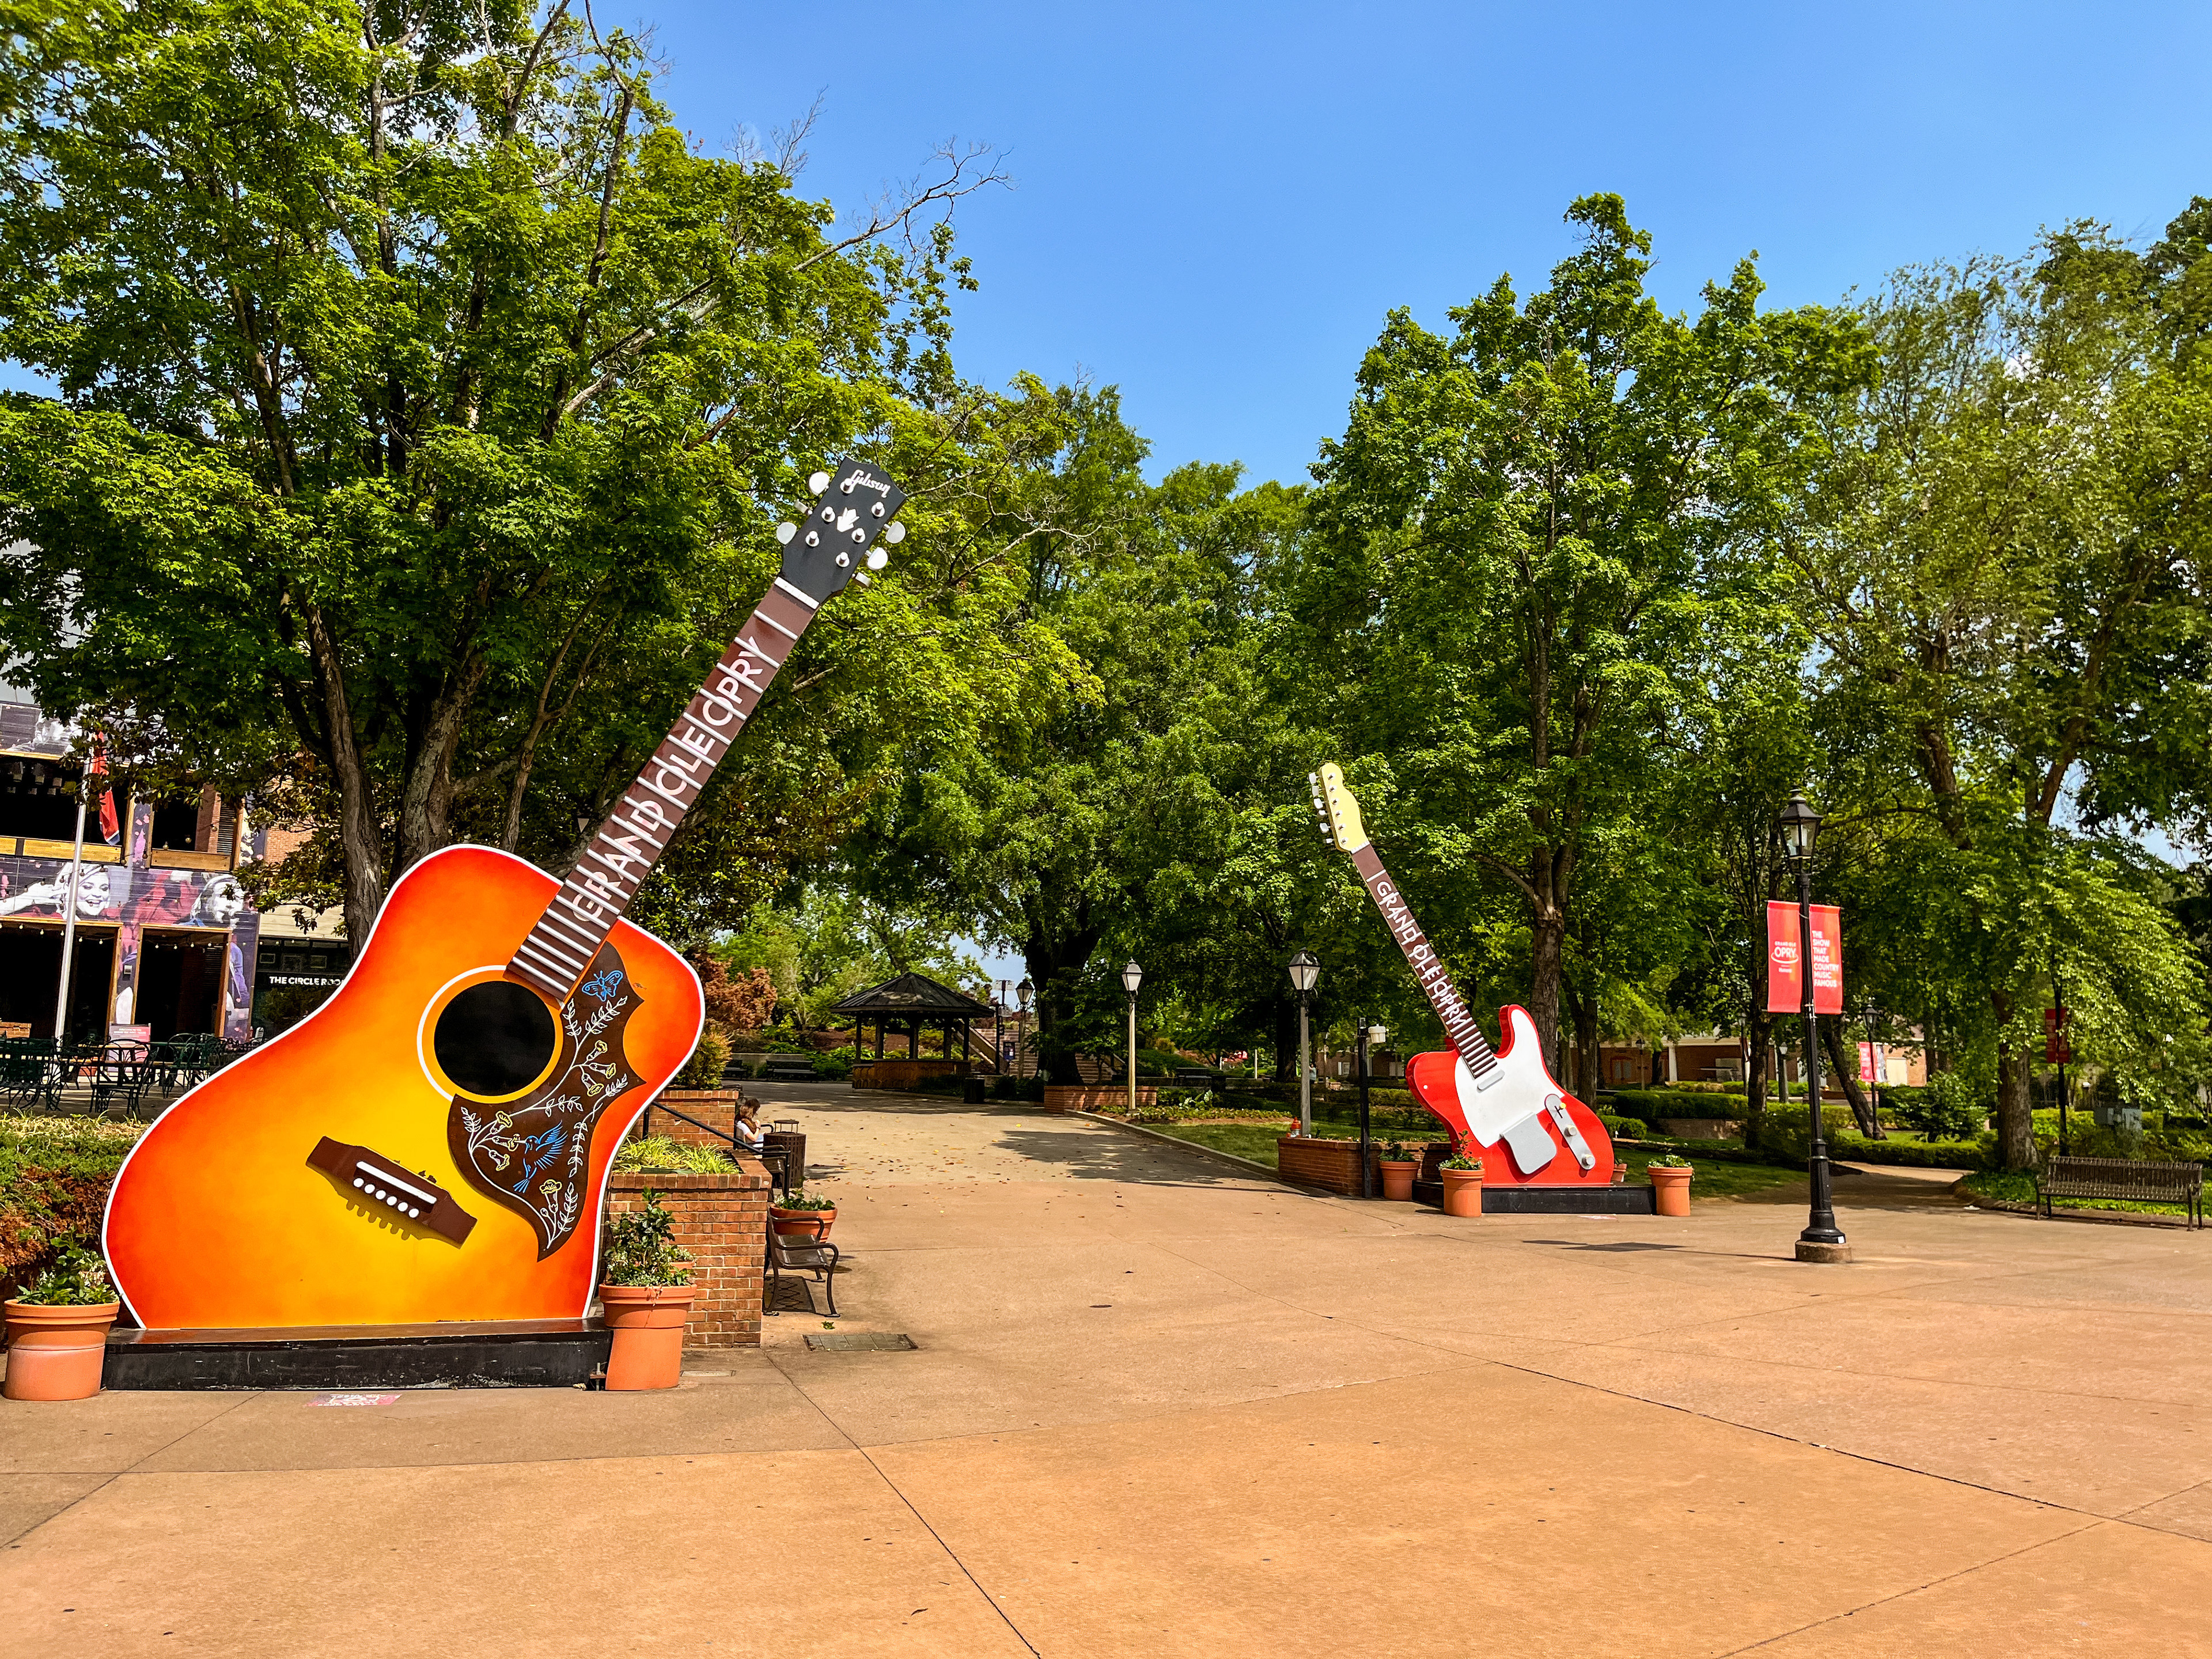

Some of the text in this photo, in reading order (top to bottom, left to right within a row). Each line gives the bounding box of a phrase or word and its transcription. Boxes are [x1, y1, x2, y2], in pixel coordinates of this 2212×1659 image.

[849, 469, 891, 498] Gibson
[572, 636, 763, 922] GRAND OLE OPRY
[1812, 930, 1823, 938] THE
[1813, 939, 1830, 947] SHOW
[1377, 881, 1417, 942] GRAND
[1434, 982, 1468, 1025] OPRY
[1774, 946, 1796, 958] OPRY
[1813, 946, 1827, 955] THAT
[1813, 963, 1839, 972] COUNTRY
[269, 976, 344, 986] THE CIRCLE ROO
[1814, 979, 1837, 987] FAMOUS
